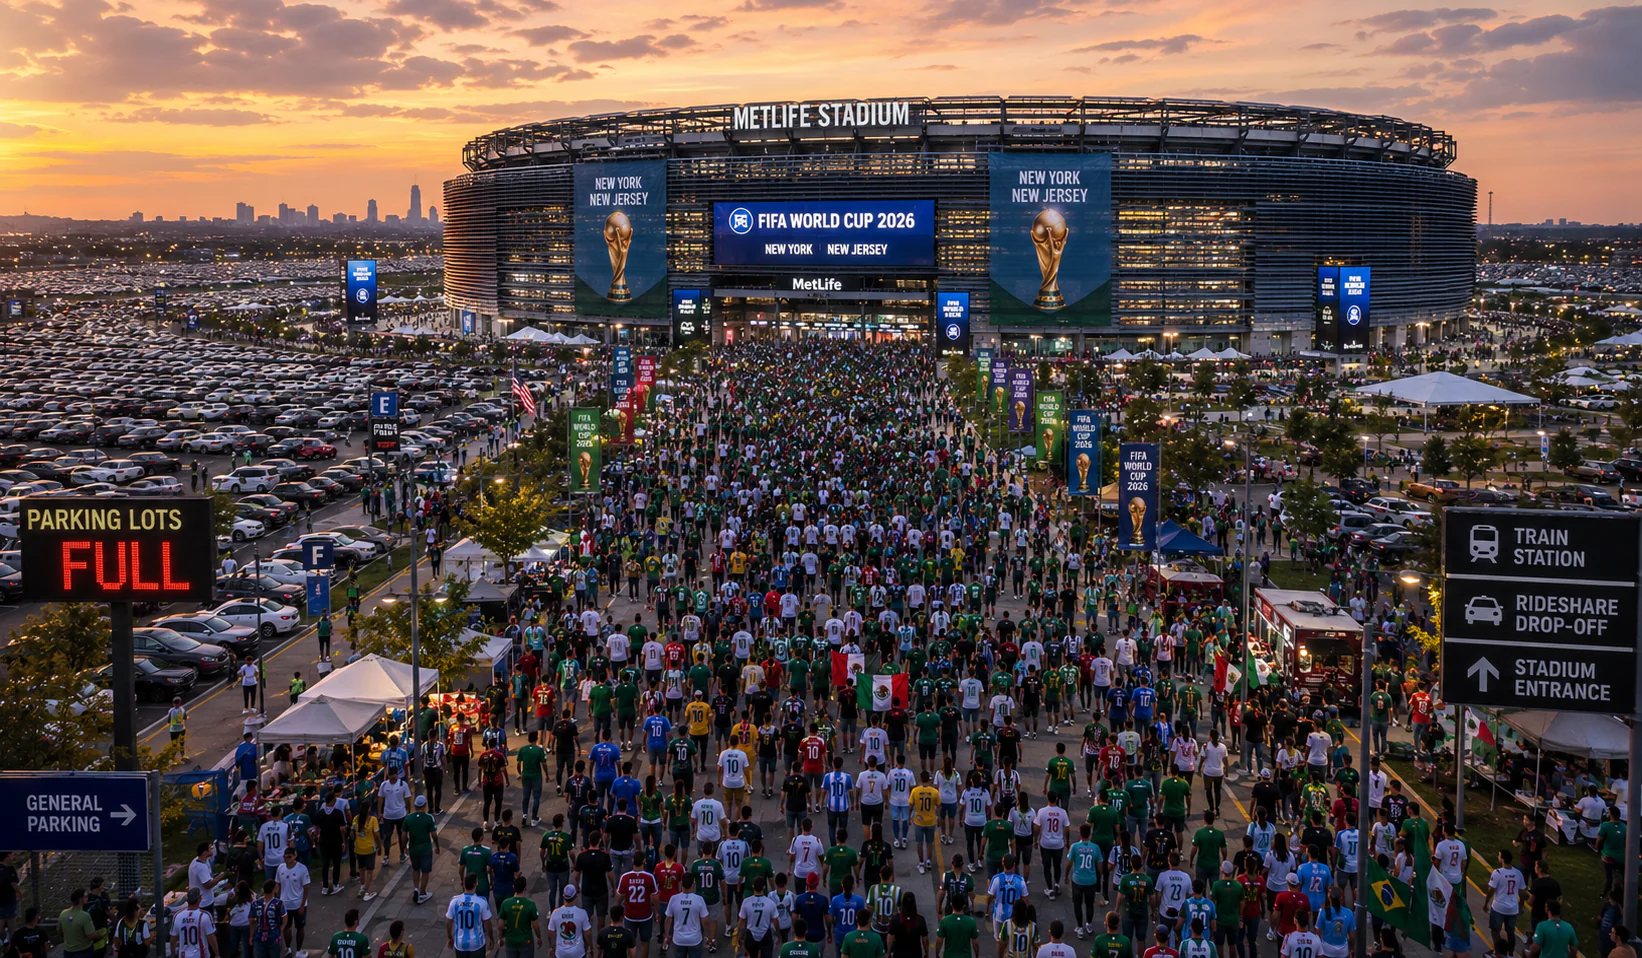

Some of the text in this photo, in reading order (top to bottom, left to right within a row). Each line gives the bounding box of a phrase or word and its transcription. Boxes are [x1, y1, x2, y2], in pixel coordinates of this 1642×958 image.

[734, 102, 909, 130] METLIFE STADIUM
[595, 176, 642, 190] NEW YORK
[1019, 170, 1080, 185] NEW YORK
[589, 192, 649, 206] NEW JERSEY
[1011, 188, 1088, 203] NEW JERSEY
[758, 212, 915, 229] FIFA WORLD CUP 2026
[765, 243, 888, 255] NEW YORK NEW JERSEY
[792, 278, 842, 291] MetLife
[379, 396, 390, 414] E
[1130, 451, 1147, 461] FIFA
[1123, 461, 1152, 471] WORLD
[1130, 471, 1147, 481] CUP
[1127, 481, 1148, 491] 2026
[27, 508, 182, 531] PARKING LOTS
[1513, 527, 1569, 546] TRAIN
[312, 545, 324, 565] F
[1513, 549, 1585, 567] STATION
[62, 541, 190, 590] FULL
[1515, 594, 1619, 616] RIDESHARE
[1515, 615, 1608, 636] DROP-OFF
[1514, 658, 1596, 679] STADIUM
[1514, 679, 1611, 701] ENTRANCE
[869, 736, 881, 751] 10
[676, 747, 688, 761] 10
[806, 745, 819, 760] 10
[726, 758, 740, 774] 10
[831, 781, 844, 797] 10
[894, 778, 907, 792] 10
[26, 794, 103, 811] GENERAL
[918, 797, 932, 812] 10
[969, 798, 982, 813] 10
[27, 815, 101, 833] PARKING
[701, 810, 714, 826] 10
[265, 832, 280, 849] 10
[726, 851, 740, 869] 10
[803, 846, 810, 863] 7
[700, 872, 713, 889] 10
[627, 885, 646, 904] 22
[999, 887, 1016, 905] 10
[876, 896, 894, 917] 10
[457, 909, 475, 931] 10
[682, 907, 690, 926] 7
[755, 909, 764, 928] 7
[180, 925, 199, 946] 10
[1013, 934, 1028, 952] 10
